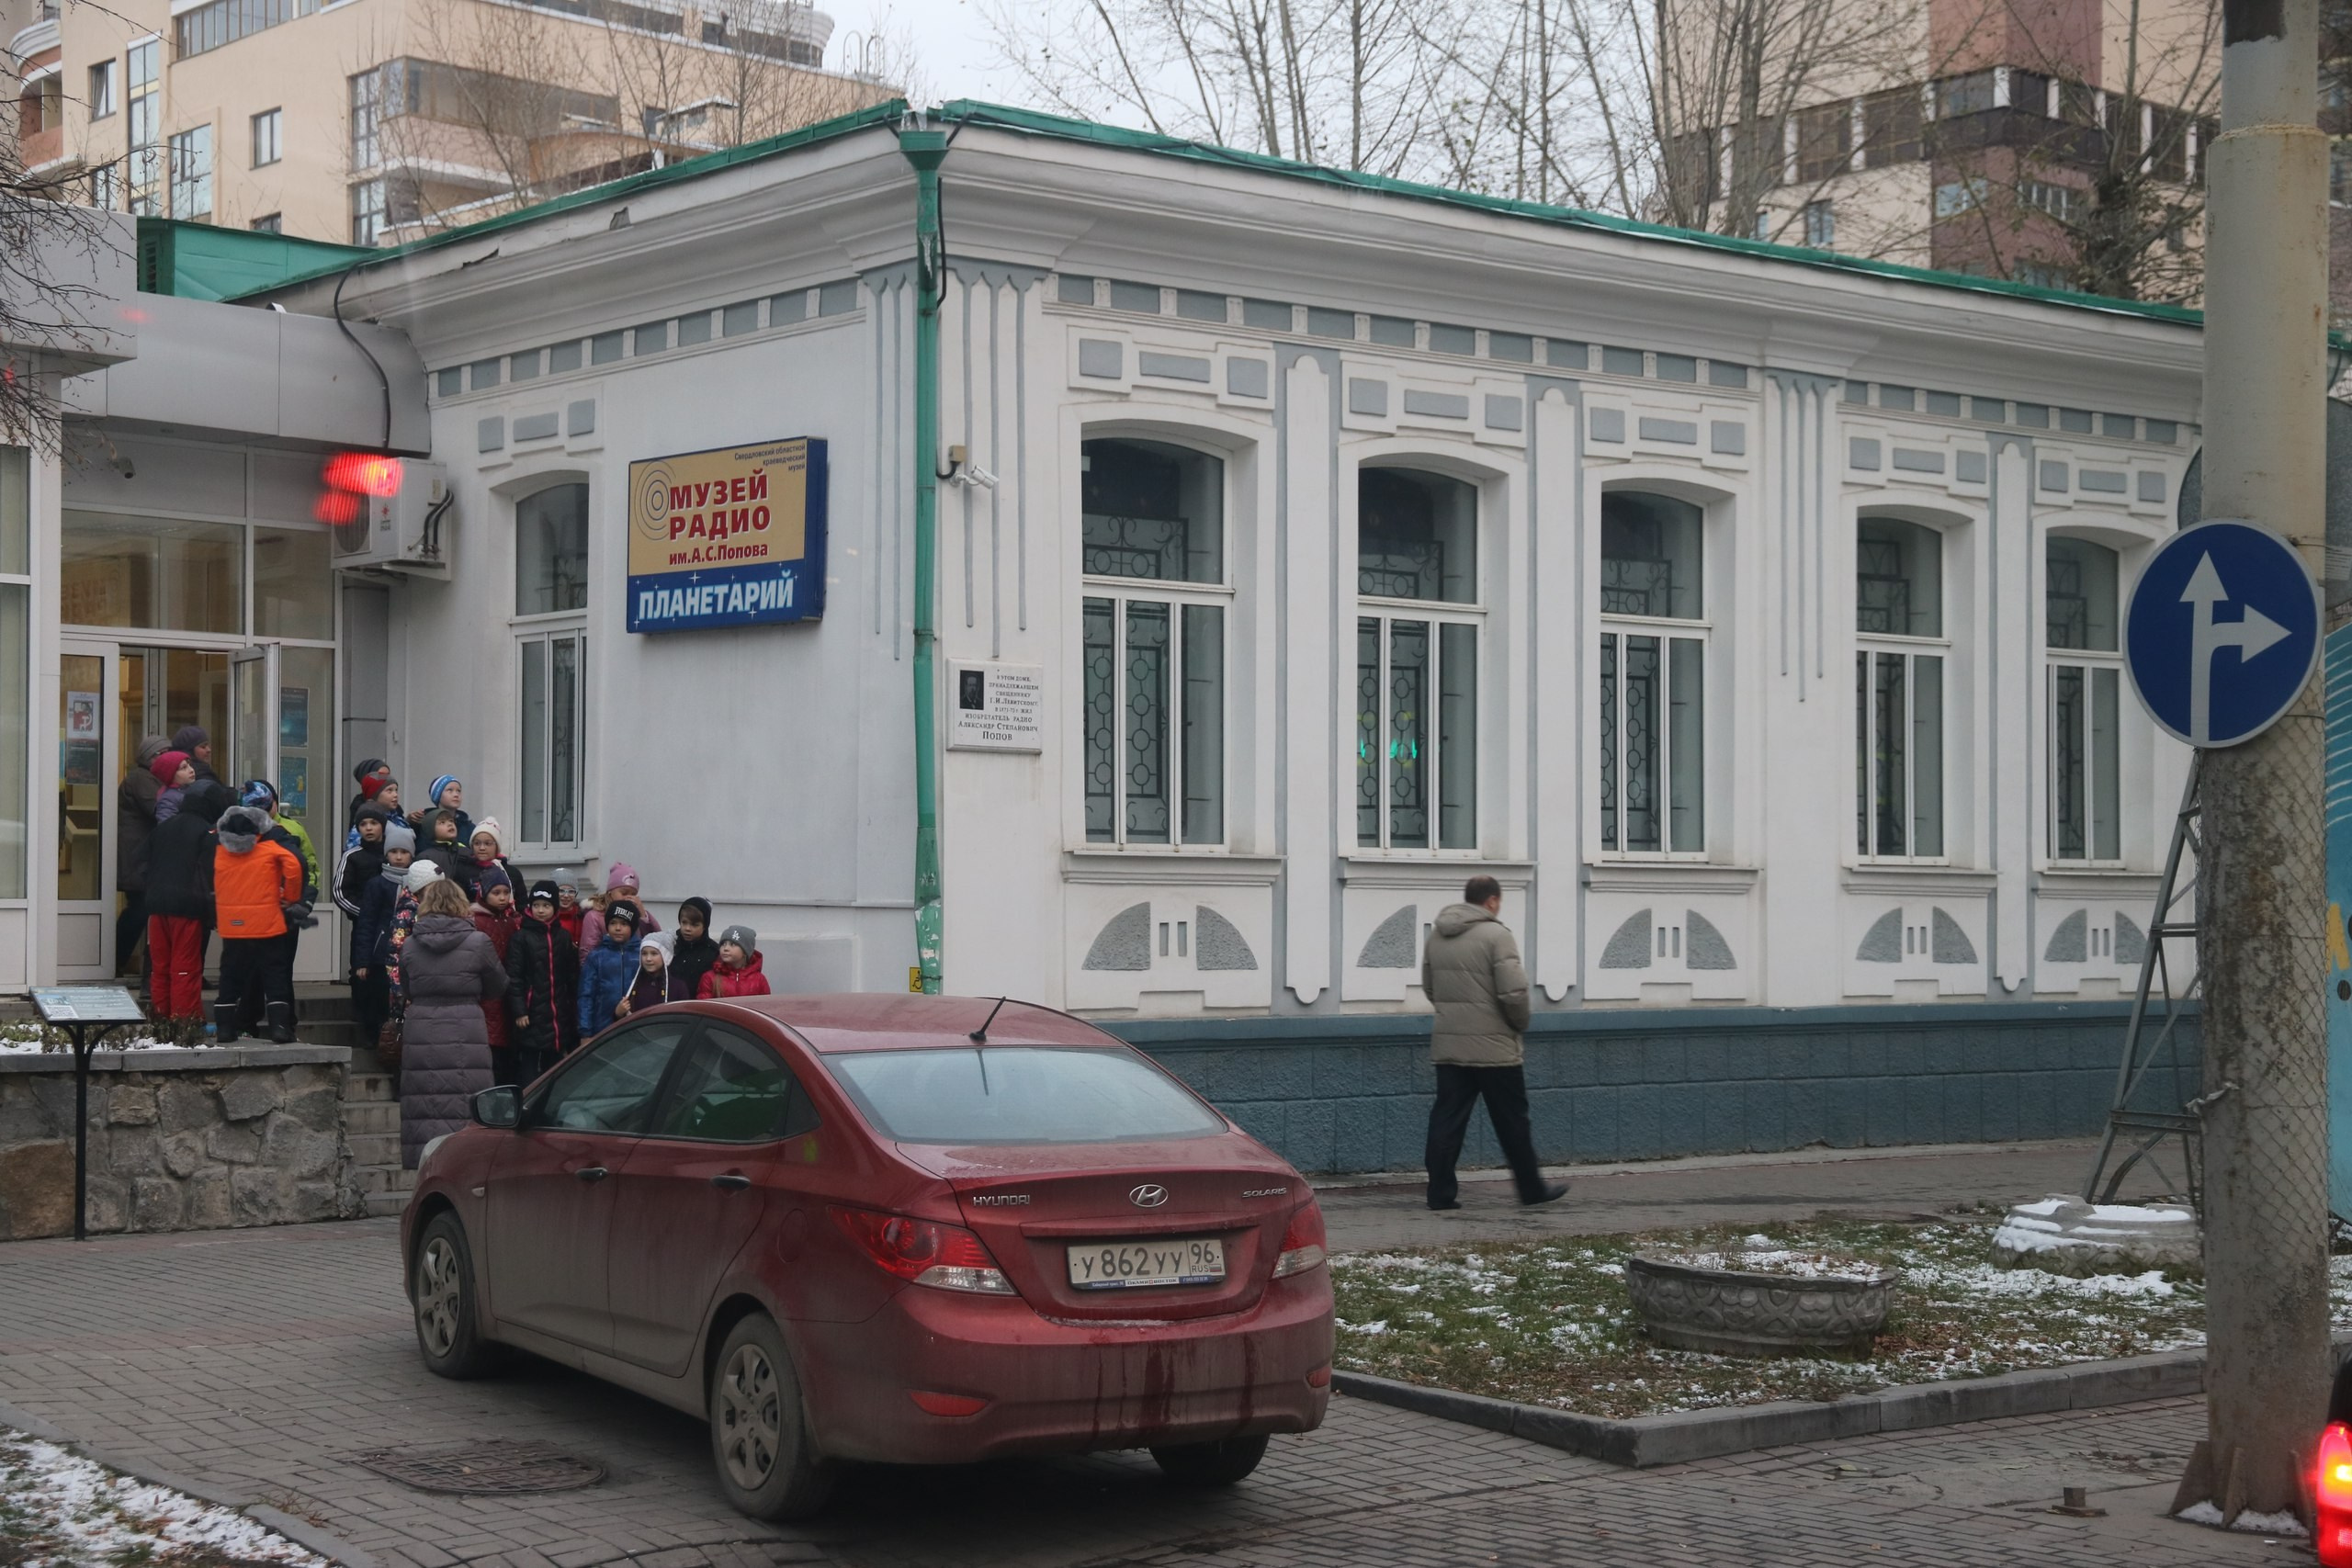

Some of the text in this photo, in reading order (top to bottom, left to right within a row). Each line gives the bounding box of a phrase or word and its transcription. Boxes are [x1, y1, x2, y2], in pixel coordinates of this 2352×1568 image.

[735, 445, 805, 460] Свердловский областной
[763, 454, 806, 466] краеведческий
[788, 463, 806, 472] музей
[670, 468, 768, 510] МУЗЕЙ
[670, 506, 771, 541] РАДИО
[639, 569, 794, 619] ПЛАНЕТАРИЙ
[1242, 1187, 1287, 1198] SOLARIS
[973, 1194, 1030, 1206] HYUNDAI
[1191, 1243, 1215, 1264] 96
[1192, 1265, 1209, 1273] RUS
